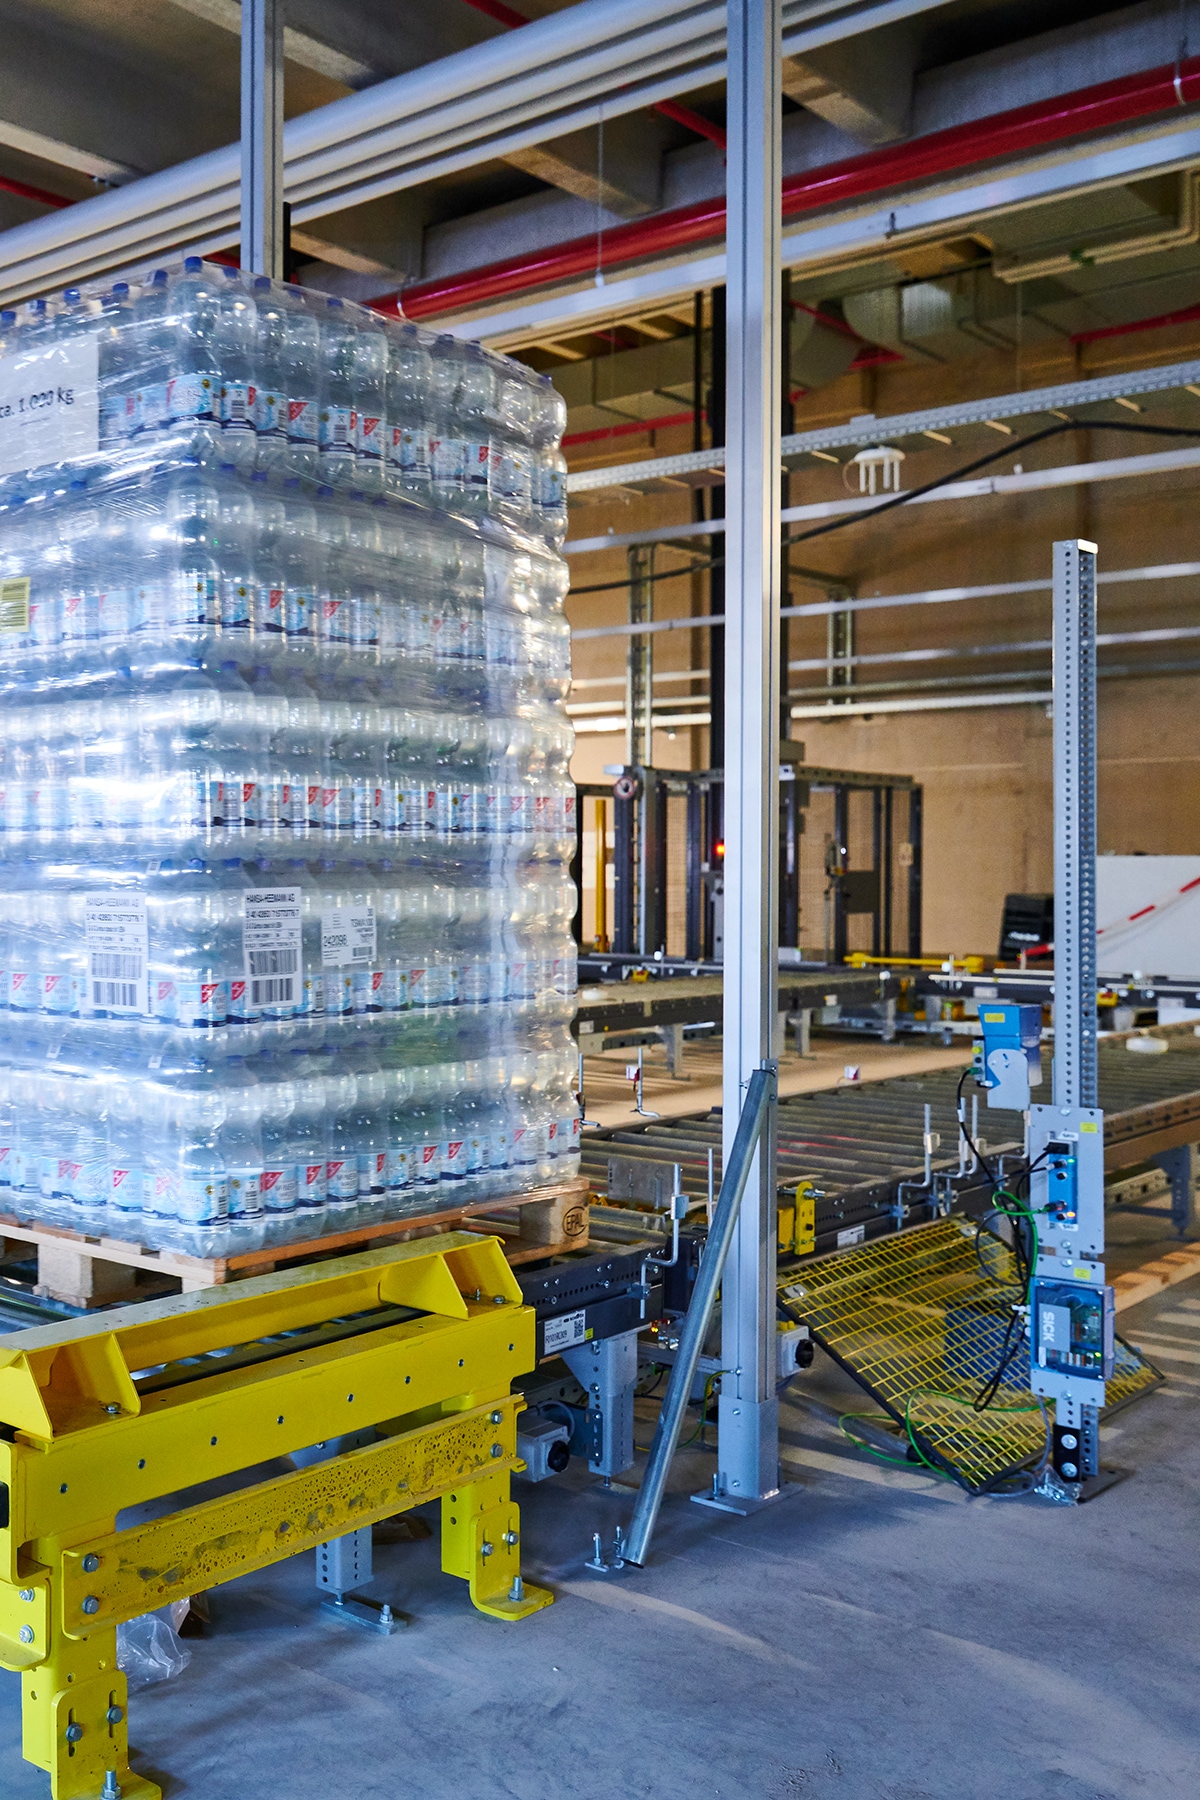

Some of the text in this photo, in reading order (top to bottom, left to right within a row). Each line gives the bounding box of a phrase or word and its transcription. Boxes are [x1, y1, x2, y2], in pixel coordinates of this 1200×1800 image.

[57, 386, 75, 405] kg
[566, 1212, 585, 1231] EPAL
[1042, 1311, 1055, 1343] SICK
